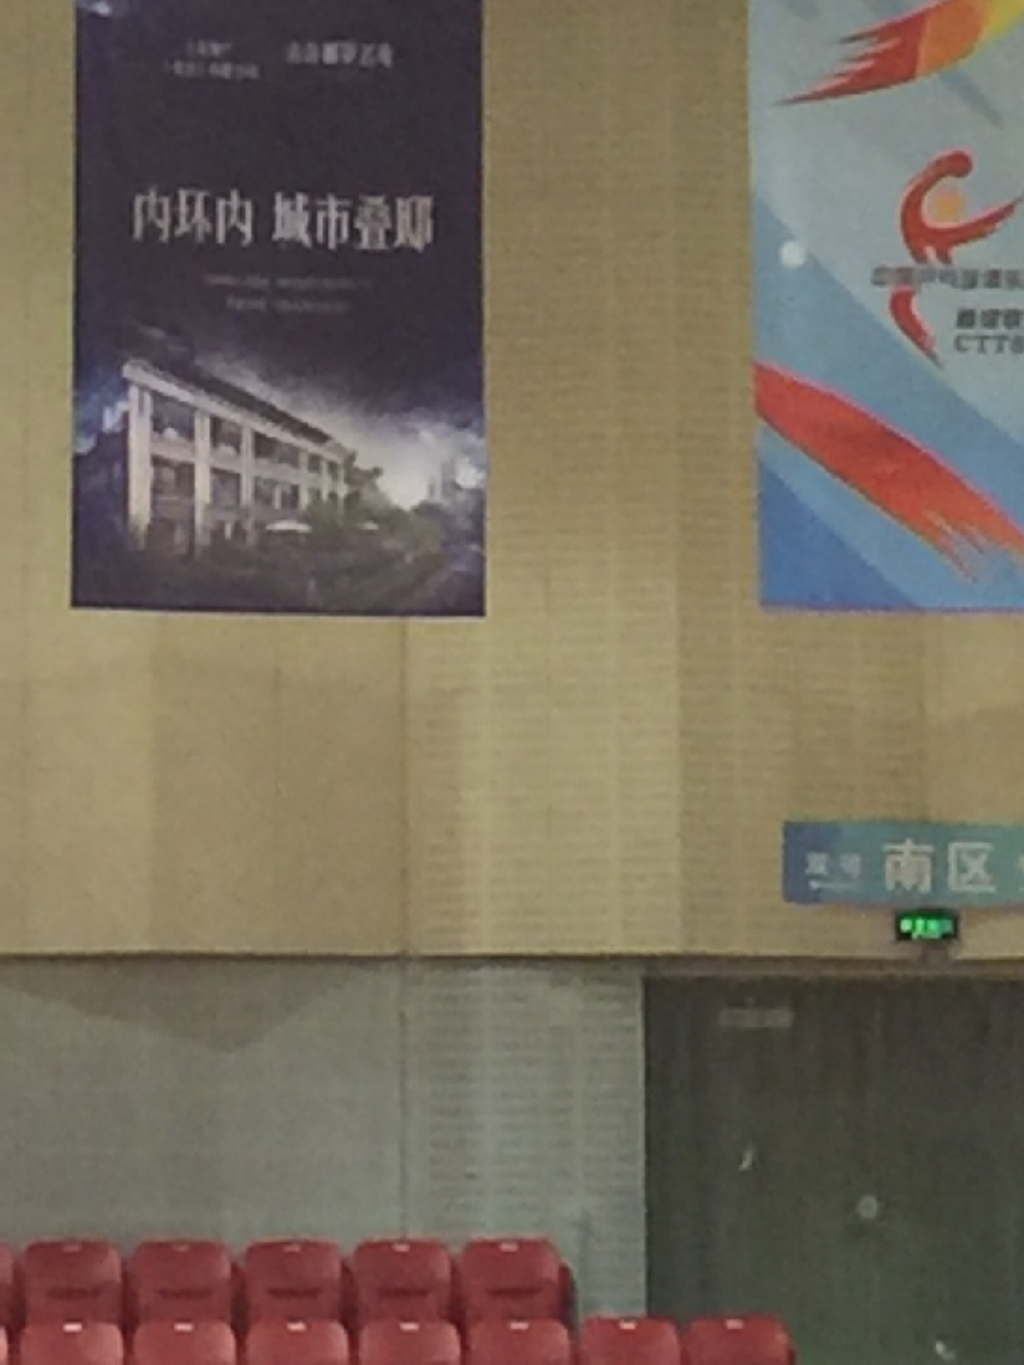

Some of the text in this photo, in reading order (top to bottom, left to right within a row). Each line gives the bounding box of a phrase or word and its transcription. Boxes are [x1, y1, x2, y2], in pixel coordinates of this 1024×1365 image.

[132, 186, 254, 247] 内环内
[882, 838, 995, 893] 南区
